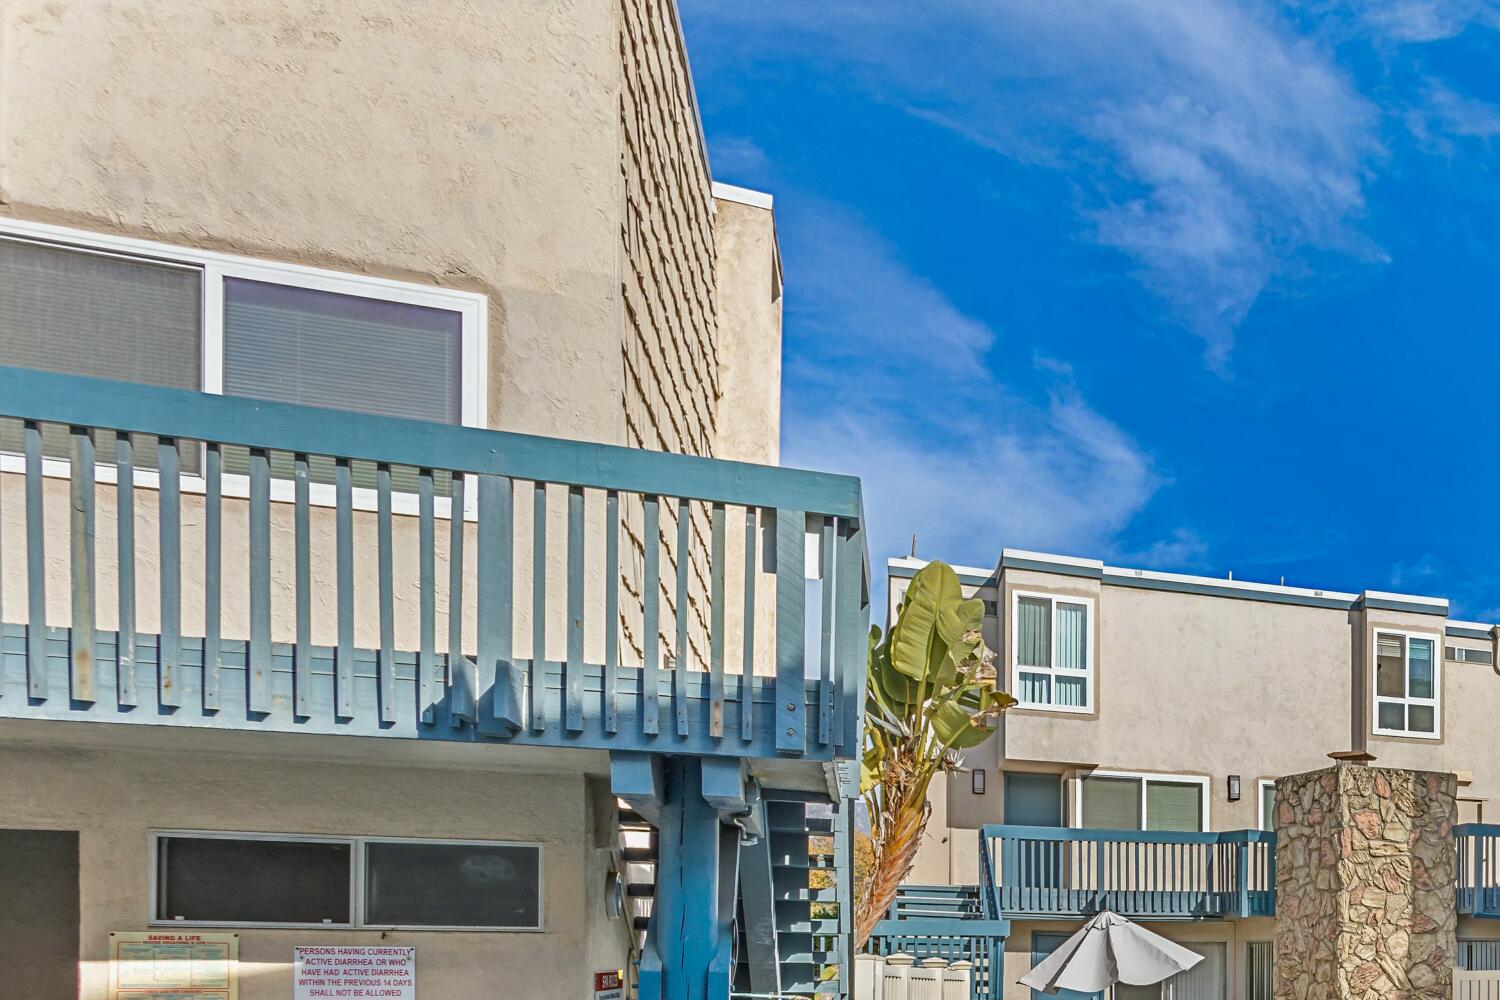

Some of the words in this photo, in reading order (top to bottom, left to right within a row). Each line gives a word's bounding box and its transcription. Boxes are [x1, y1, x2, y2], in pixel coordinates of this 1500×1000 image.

[309, 989, 333, 997] SHALL
[336, 989, 351, 997] NOT
[353, 989, 364, 997] BE
[366, 989, 402, 997] ALLOWED
